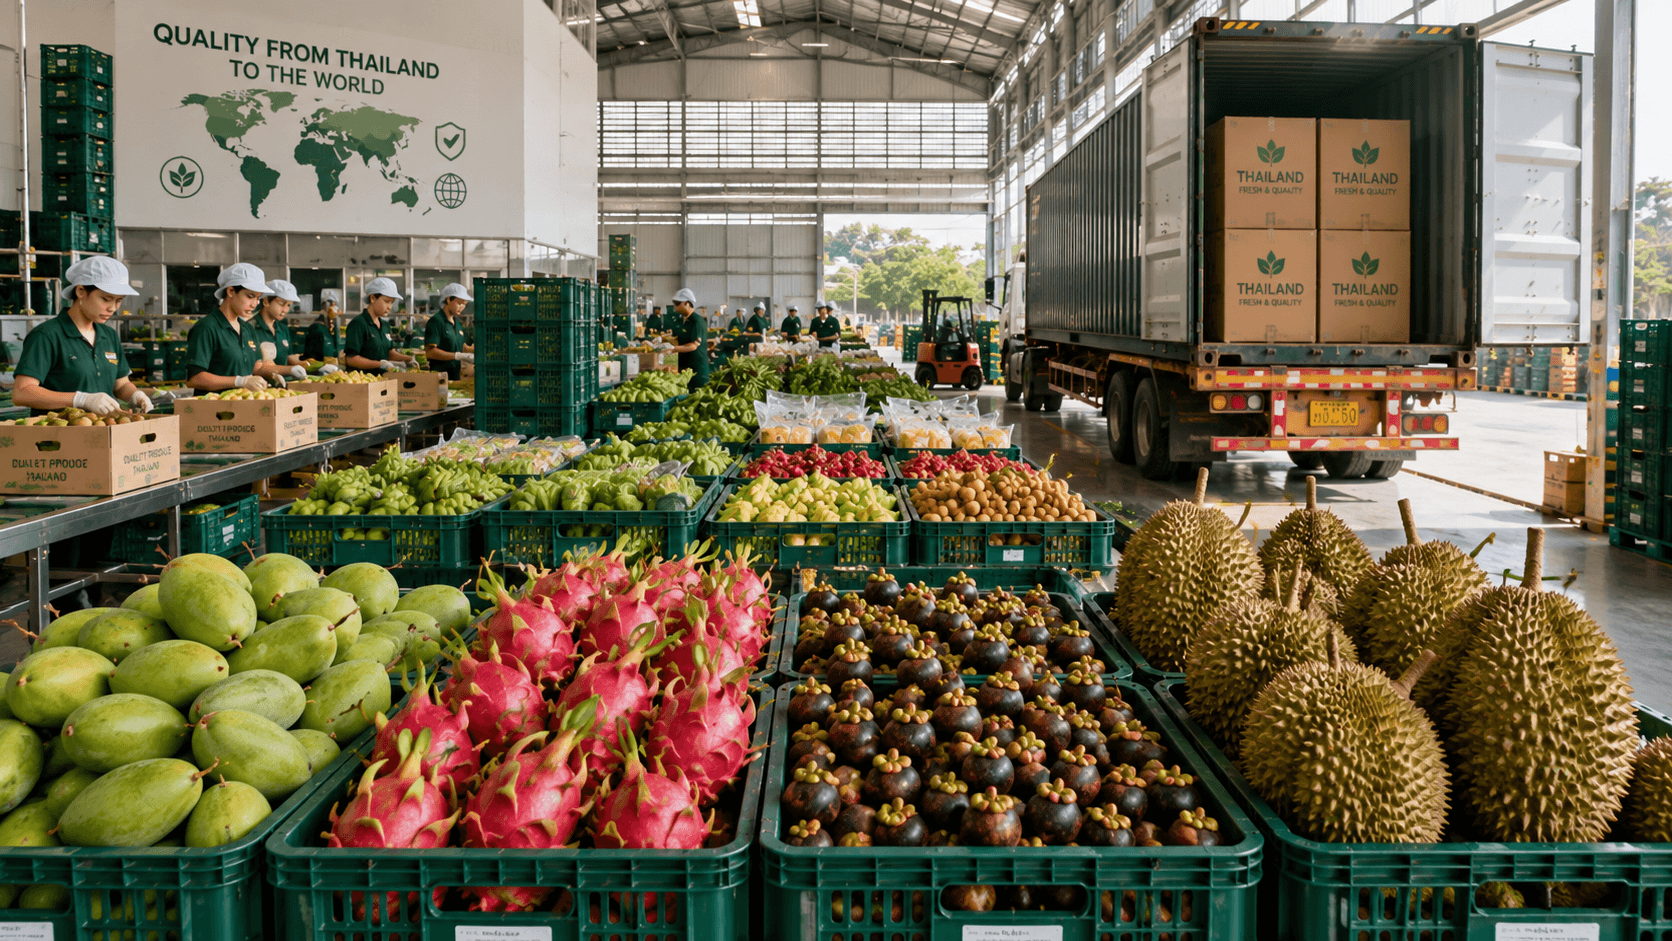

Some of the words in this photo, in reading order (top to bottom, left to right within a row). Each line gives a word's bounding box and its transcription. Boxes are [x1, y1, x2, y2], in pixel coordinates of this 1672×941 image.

[153, 22, 259, 55] QUALITY
[266, 39, 329, 65] FROM
[335, 49, 440, 79] THAILAND
[229, 59, 260, 80] TO
[266, 64, 307, 86] THE
[313, 71, 384, 95] WORLD
[1236, 170, 1304, 184] THAILAND
[1332, 172, 1399, 185] THAILAND
[1239, 186, 1262, 194] FRESH
[1272, 186, 1303, 194] QUALITY
[1334, 187, 1358, 195] FRESH
[1366, 187, 1397, 195] QUALITY
[1236, 282, 1304, 295] THAILAND
[1332, 283, 1399, 296] THAILAND
[1238, 298, 1262, 306] FRESH
[1271, 298, 1303, 306] QUALITY
[1334, 299, 1358, 307] FRESH
[1366, 299, 1397, 307] QUALITY
